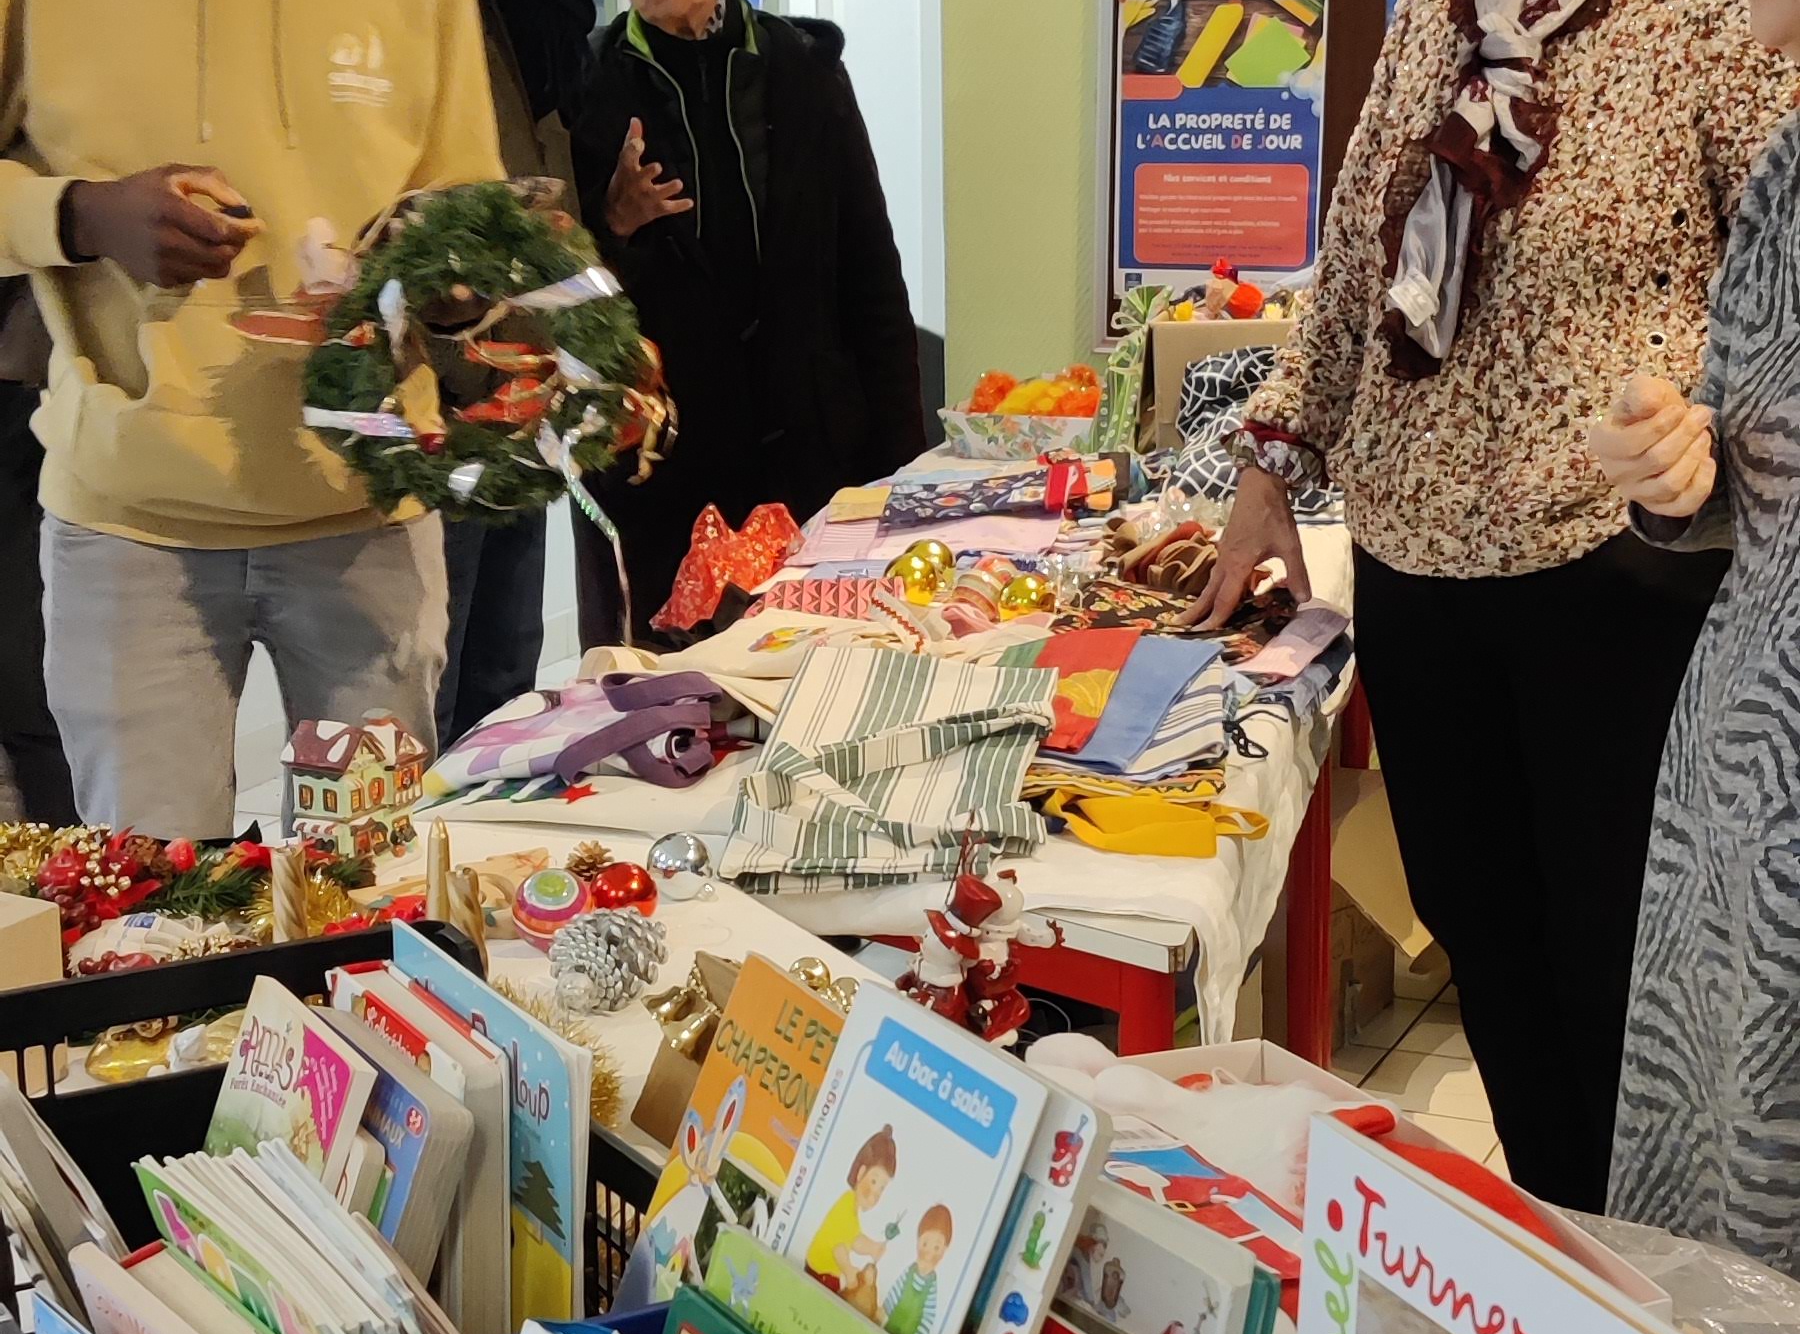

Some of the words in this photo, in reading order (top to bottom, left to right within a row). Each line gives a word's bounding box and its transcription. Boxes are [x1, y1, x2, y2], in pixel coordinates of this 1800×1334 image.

[1148, 113, 1171, 130] LA
[1175, 108, 1265, 130] PROPRETÉ
[1269, 113, 1292, 130] DE
[1136, 133, 1226, 151] L'ACCUEIL
[1231, 133, 1253, 150] DE
[1257, 133, 1302, 150] JOUR
[774, 999, 804, 1043] LE
[884, 1040, 909, 1072] Au
[907, 1051, 936, 1092] bac
[937, 1070, 953, 1101] à
[949, 1085, 996, 1128] sable
[782, 1165, 808, 1216] livres
[804, 1068, 844, 1160] d'images
